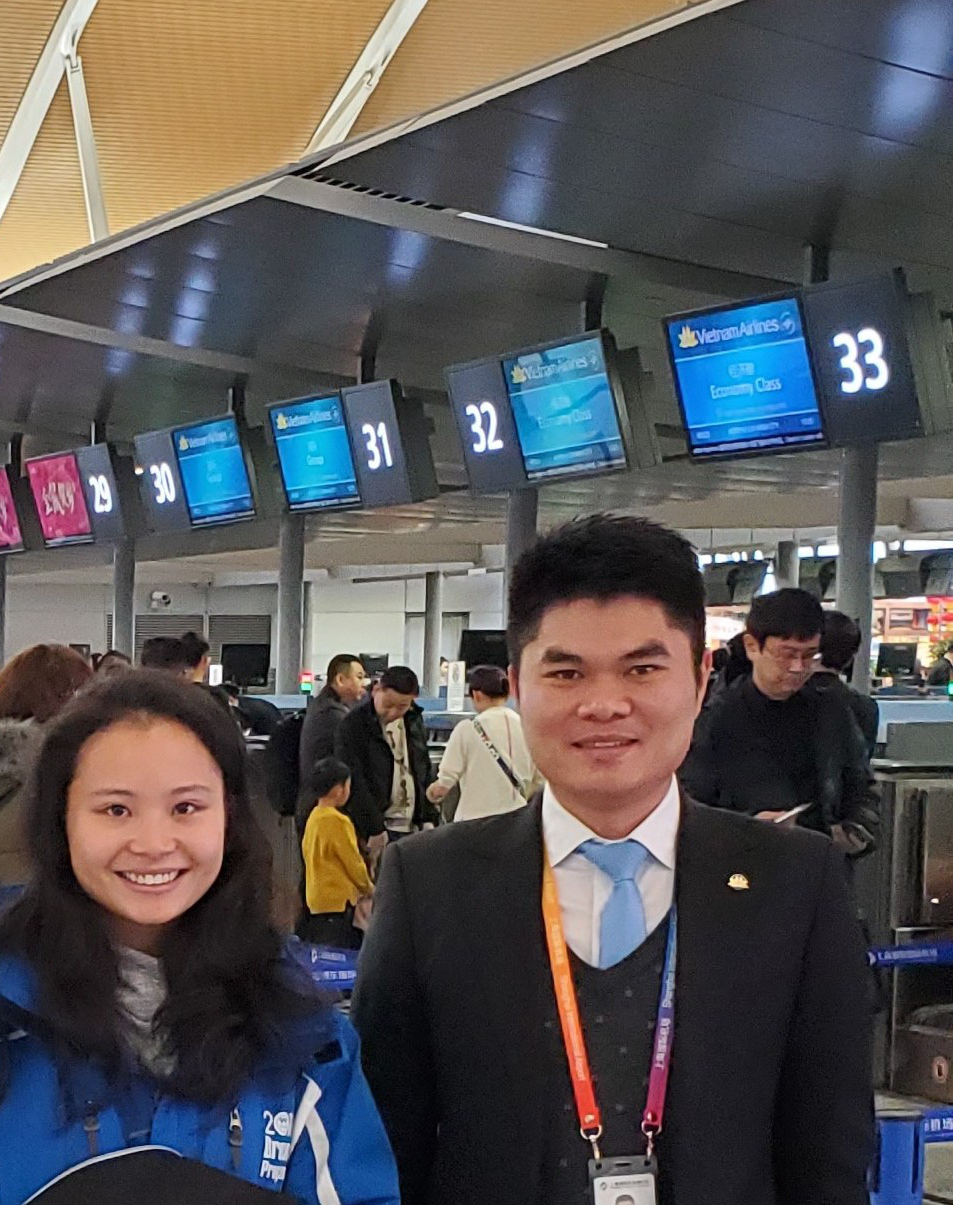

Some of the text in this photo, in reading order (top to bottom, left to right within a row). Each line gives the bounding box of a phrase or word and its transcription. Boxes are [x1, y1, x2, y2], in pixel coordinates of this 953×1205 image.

[833, 327, 889, 393] 33
[362, 422, 393, 470] 31
[465, 401, 503, 453] 32
[89, 475, 112, 513] 29
[149, 462, 176, 503] 30
